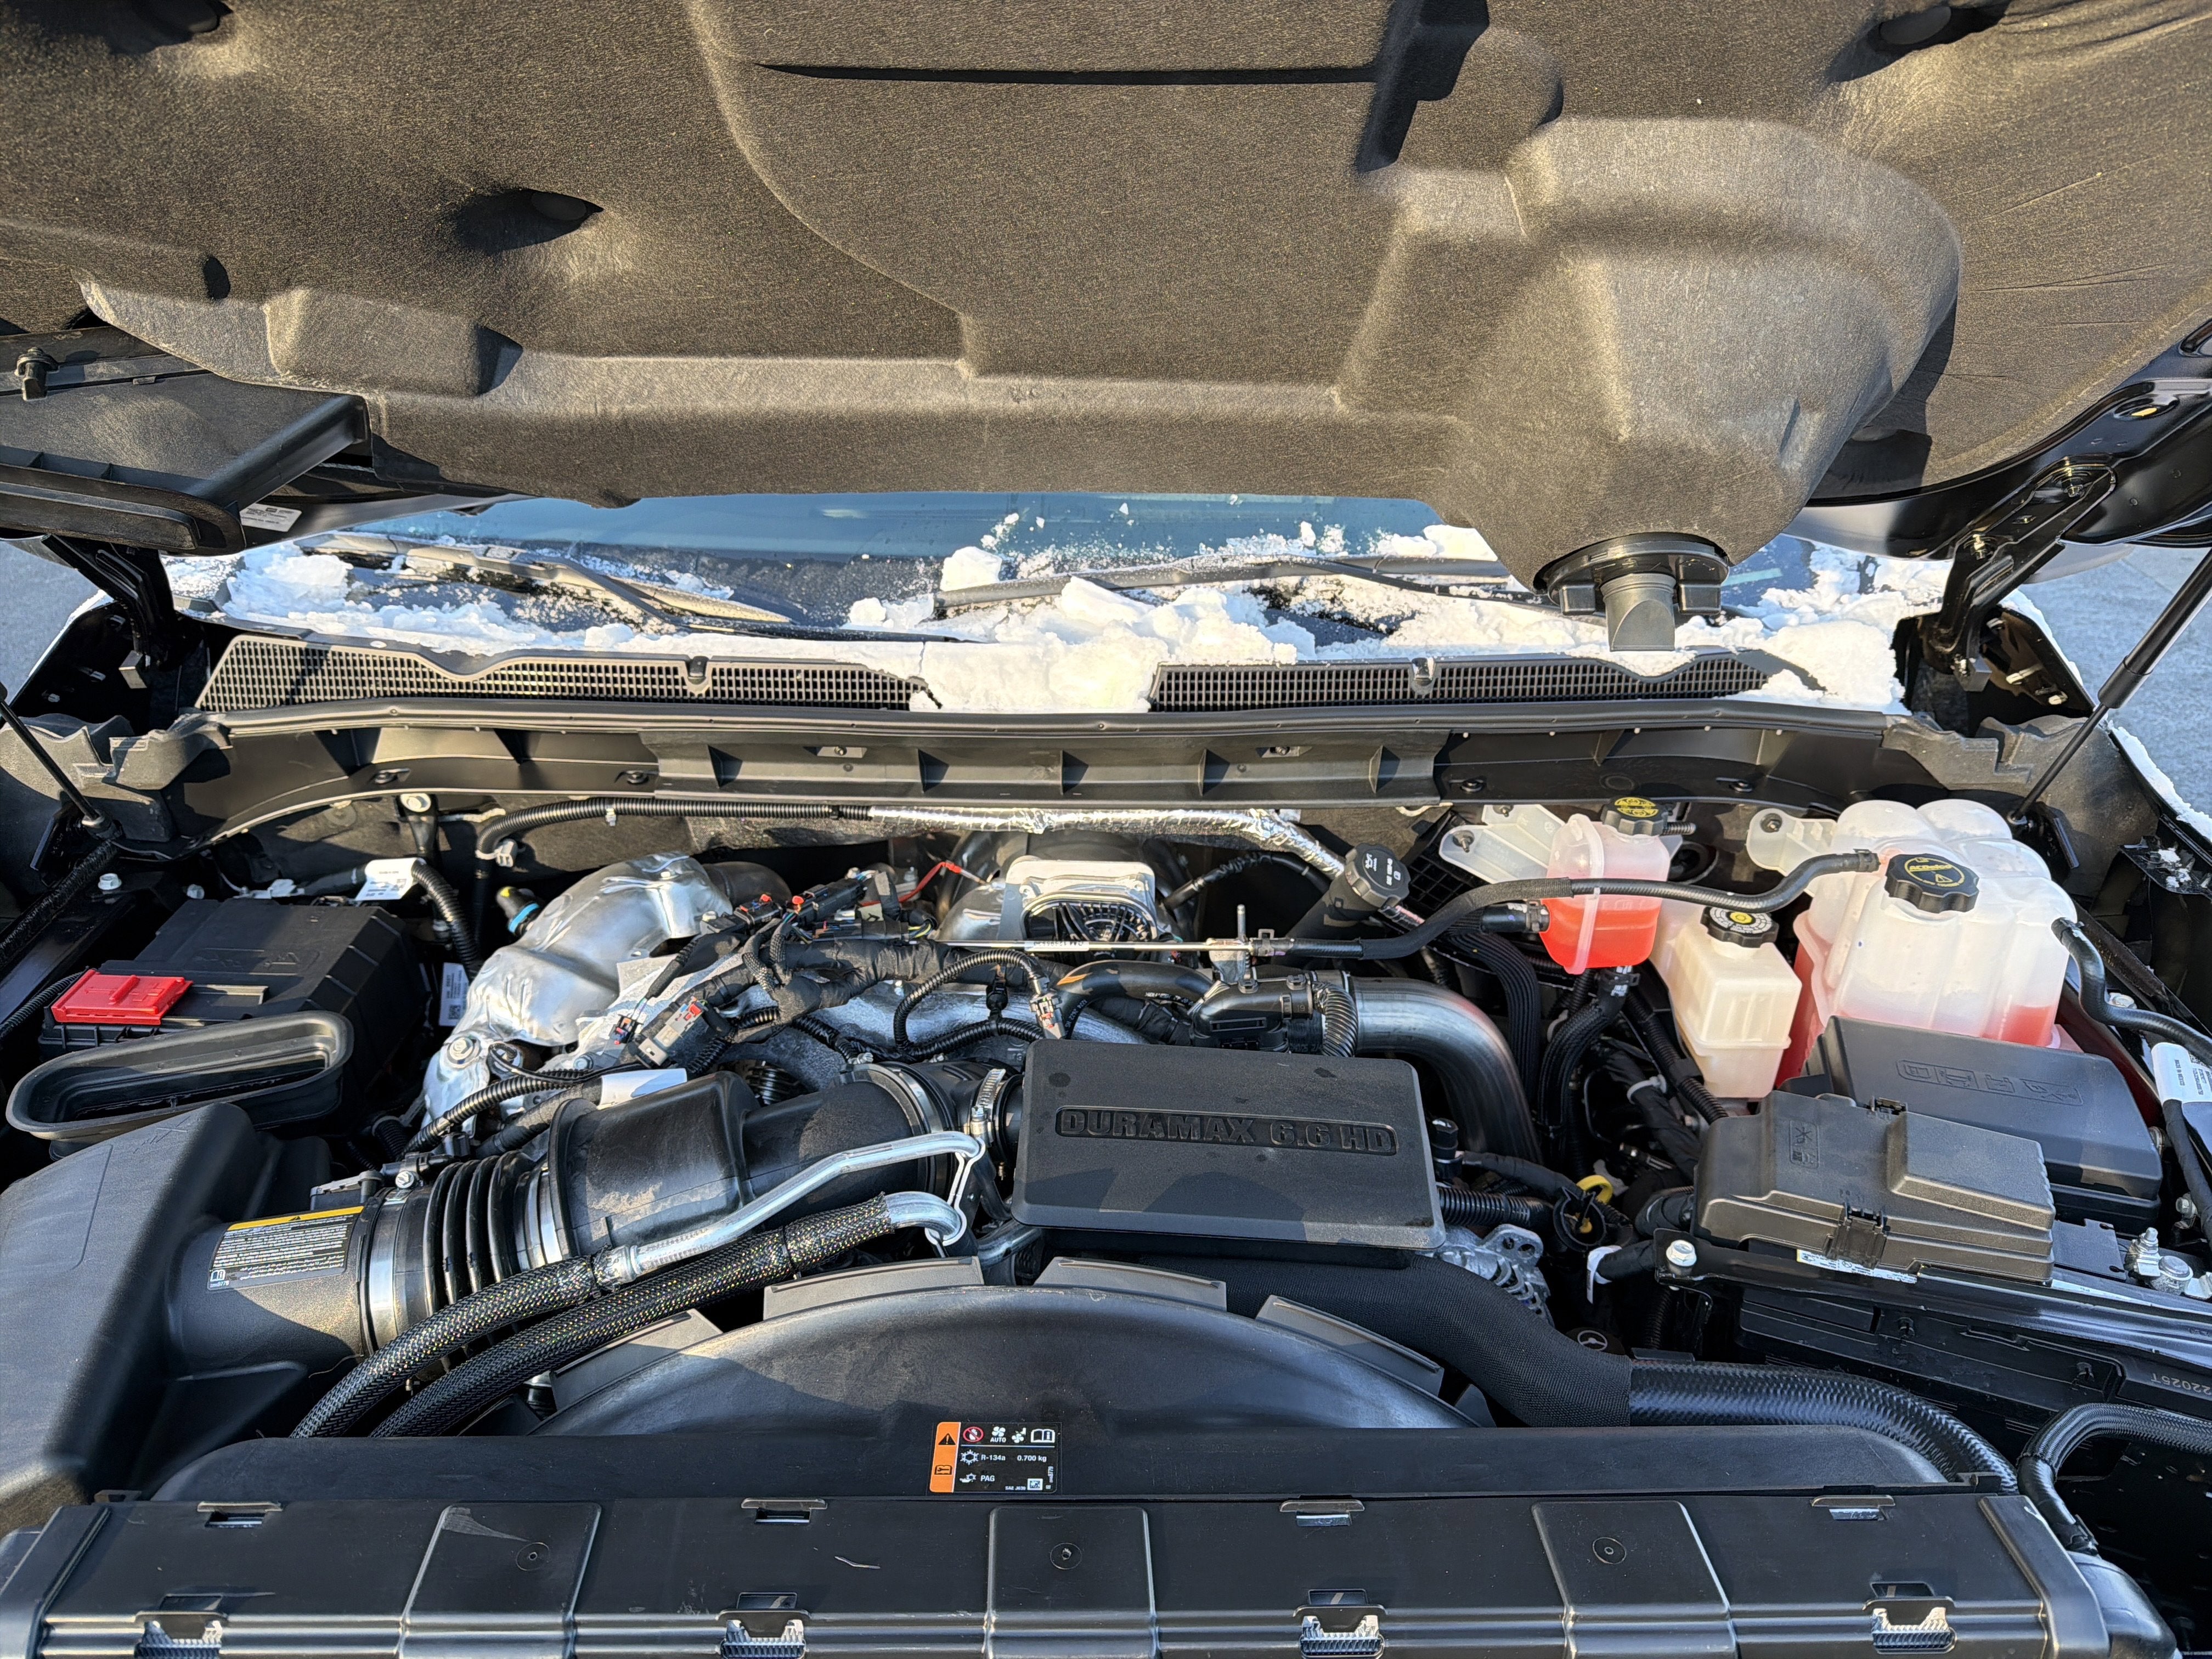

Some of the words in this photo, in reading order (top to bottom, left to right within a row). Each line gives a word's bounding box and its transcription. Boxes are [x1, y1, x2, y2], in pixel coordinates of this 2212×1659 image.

[1061, 1110, 1255, 1143] DURAMAX
[1269, 1121, 1331, 1147] 6.6
[1339, 1125, 1393, 1152] HD
[2150, 1373, 2212, 1395] 22025T
